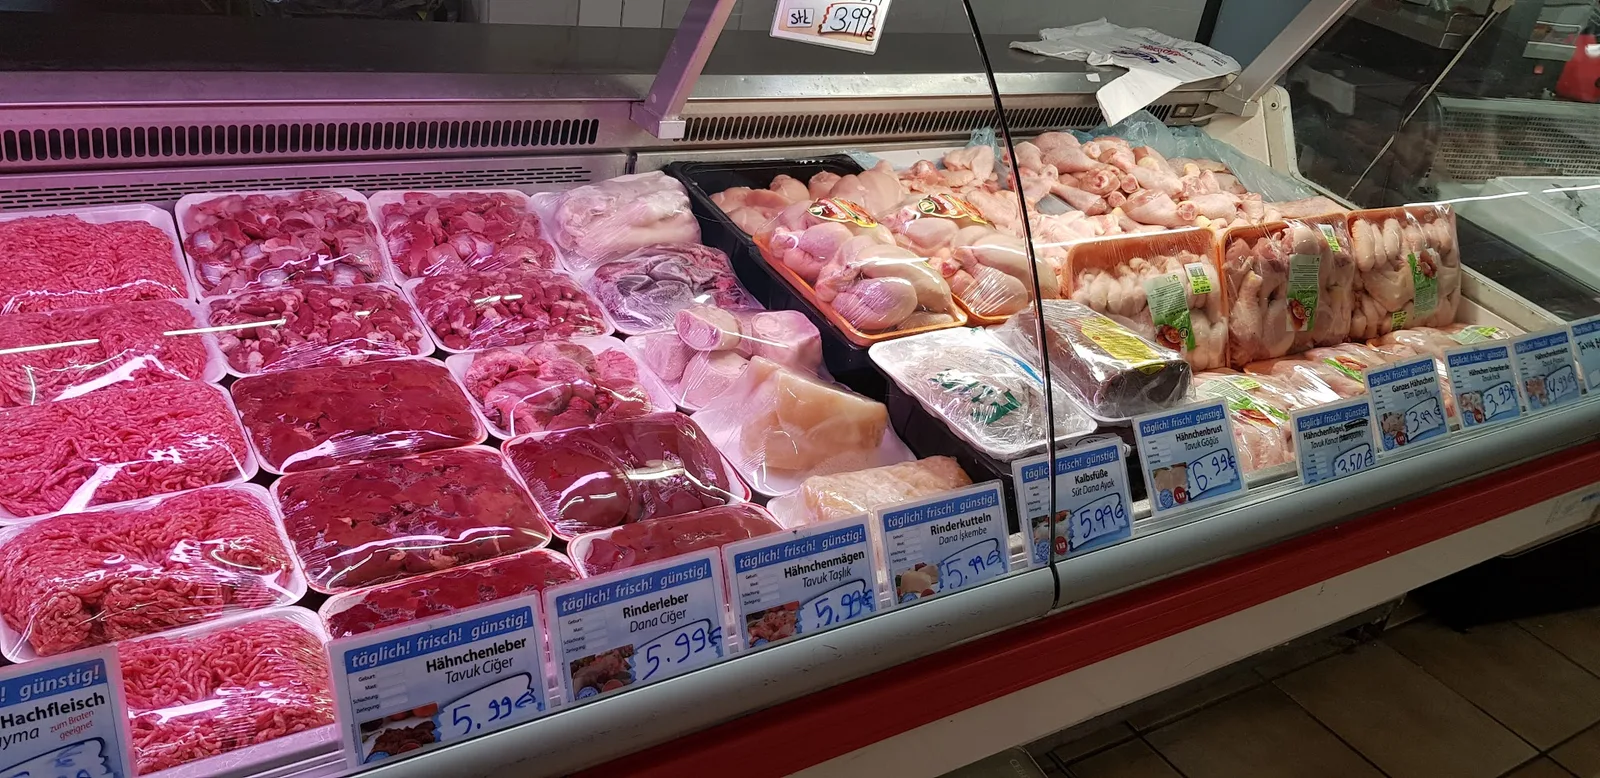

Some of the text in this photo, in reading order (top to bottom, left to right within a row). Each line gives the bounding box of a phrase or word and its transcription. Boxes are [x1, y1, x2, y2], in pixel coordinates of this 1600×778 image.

[1370, 362, 1432, 386] täglich! frisch! günstig!
[1392, 376, 1434, 392] Ganzes Hähnchen
[1143, 409, 1222, 434] täglich! frisch! günstig!
[1300, 414, 1322, 430] täglich!
[1324, 412, 1342, 424] frisch!
[1345, 406, 1368, 420] günstig!
[1176, 424, 1223, 442] Hähnchenbrust
[1184, 436, 1219, 452] Tavuk Göğüs
[1025, 449, 1116, 480] täglic frisch! günstig!
[1074, 469, 1108, 484] Kalbsfüße
[1072, 478, 1115, 497] Süt Dana Ayak
[887, 492, 996, 528] täglich! frisch! günstig!
[930, 513, 992, 536] Rinderkutteln
[739, 528, 862, 569] täglich! frisch! günstig!
[939, 535, 958, 546] Dana
[784, 550, 865, 578] Hähnchenmägen
[562, 563, 708, 612] täglich! frisch! günstig!
[802, 566, 852, 588] Tavuk Taşlık
[622, 592, 688, 618] Rinderleber
[630, 608, 686, 633] Dana Ciğer
[351, 611, 528, 668] täglich! frisch! günstig!
[426, 636, 527, 674] Hähnchenleber
[445, 655, 514, 684] Tavuk Ciğer
[20, 664, 100, 702] günstig!
[0, 692, 105, 729] Hachfleisch
[50, 710, 94, 733] zum Braten
[60, 720, 94, 740] geeignet
